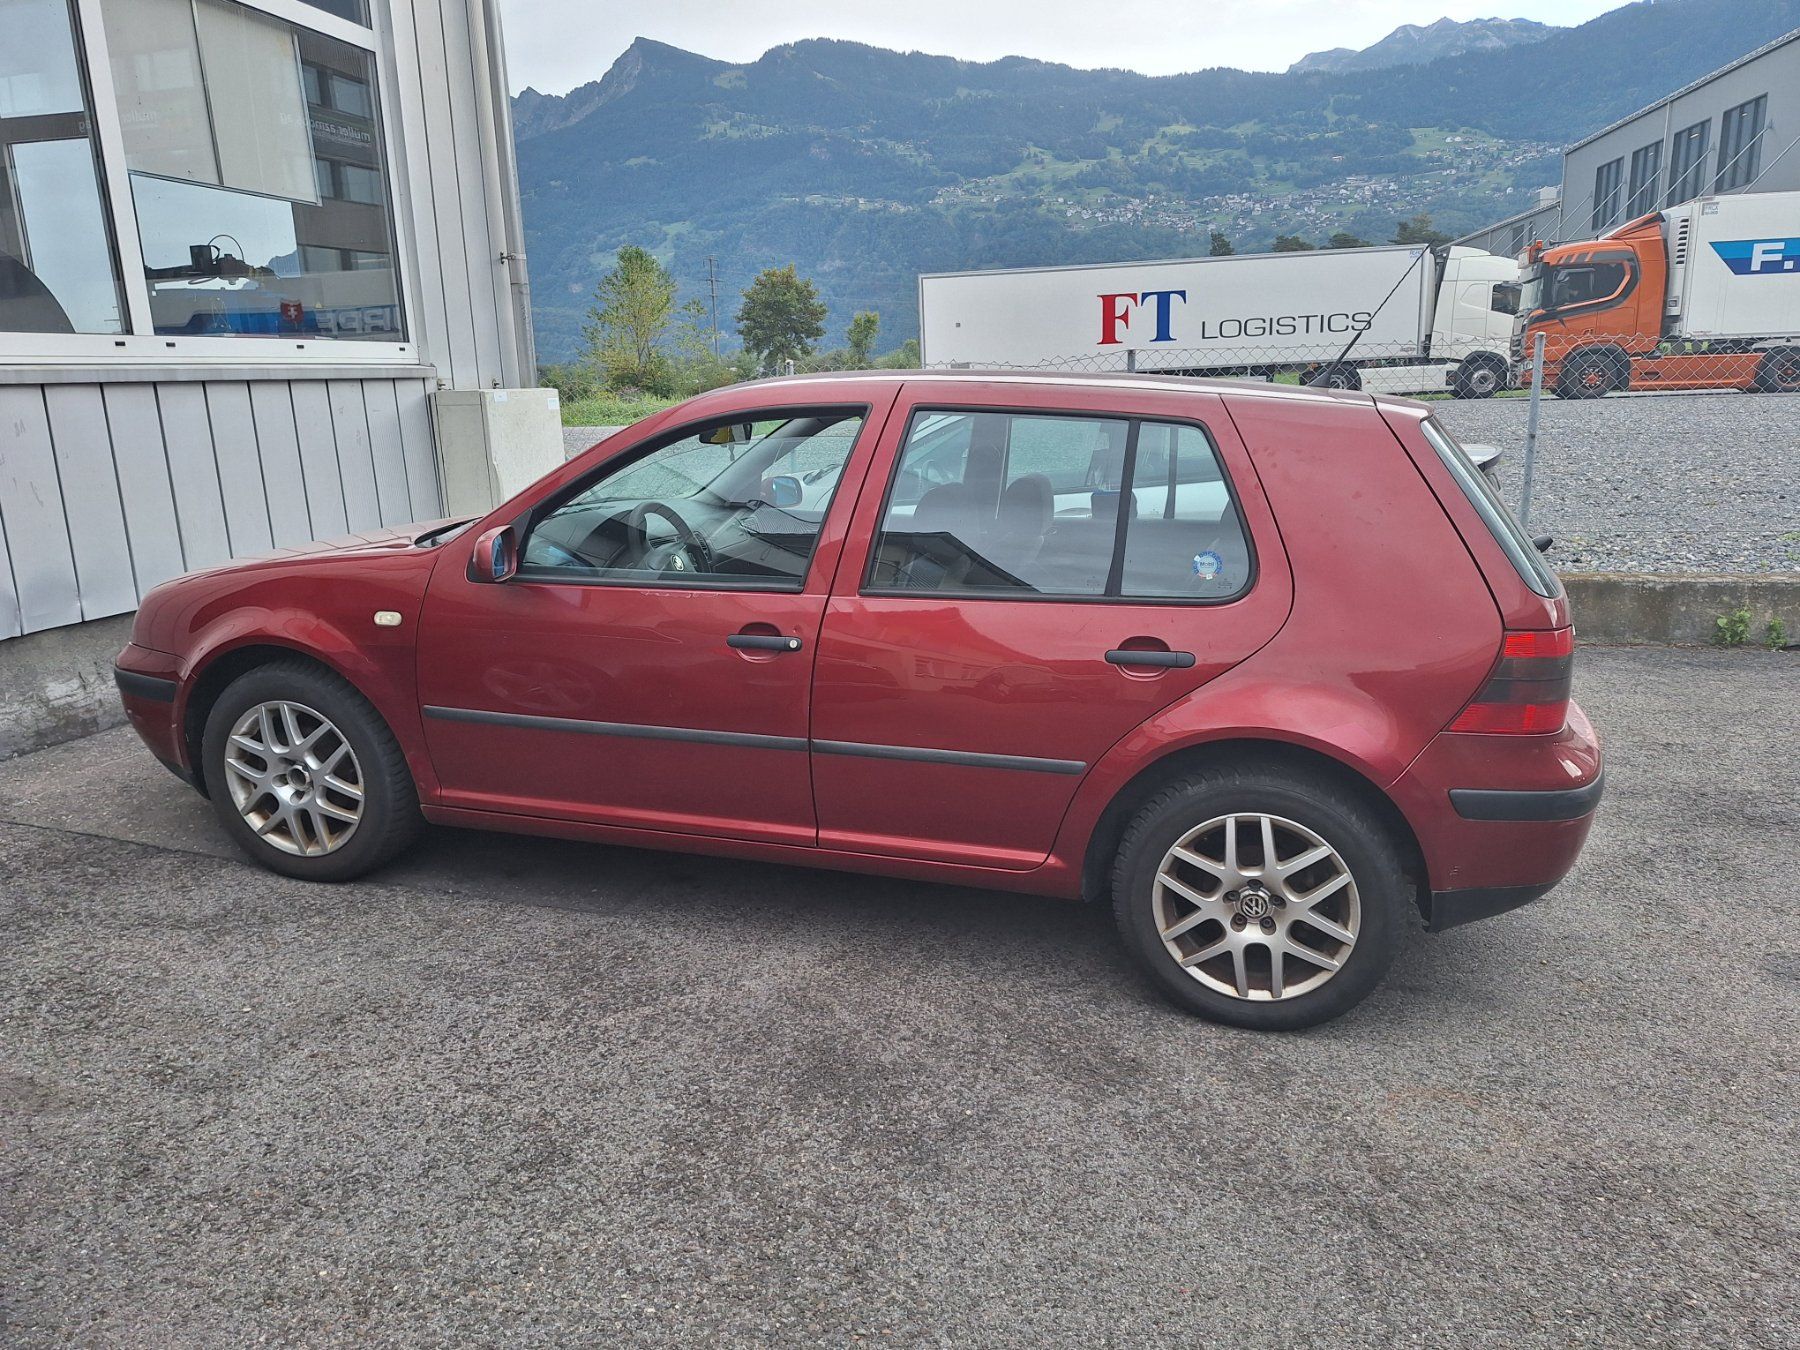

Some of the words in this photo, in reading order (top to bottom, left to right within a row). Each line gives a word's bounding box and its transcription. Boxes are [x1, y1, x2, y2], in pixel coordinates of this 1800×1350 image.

[1751, 242, 1793, 271] F.
[1097, 290, 1186, 344] FT
[1202, 312, 1372, 340] LOGISTICS
